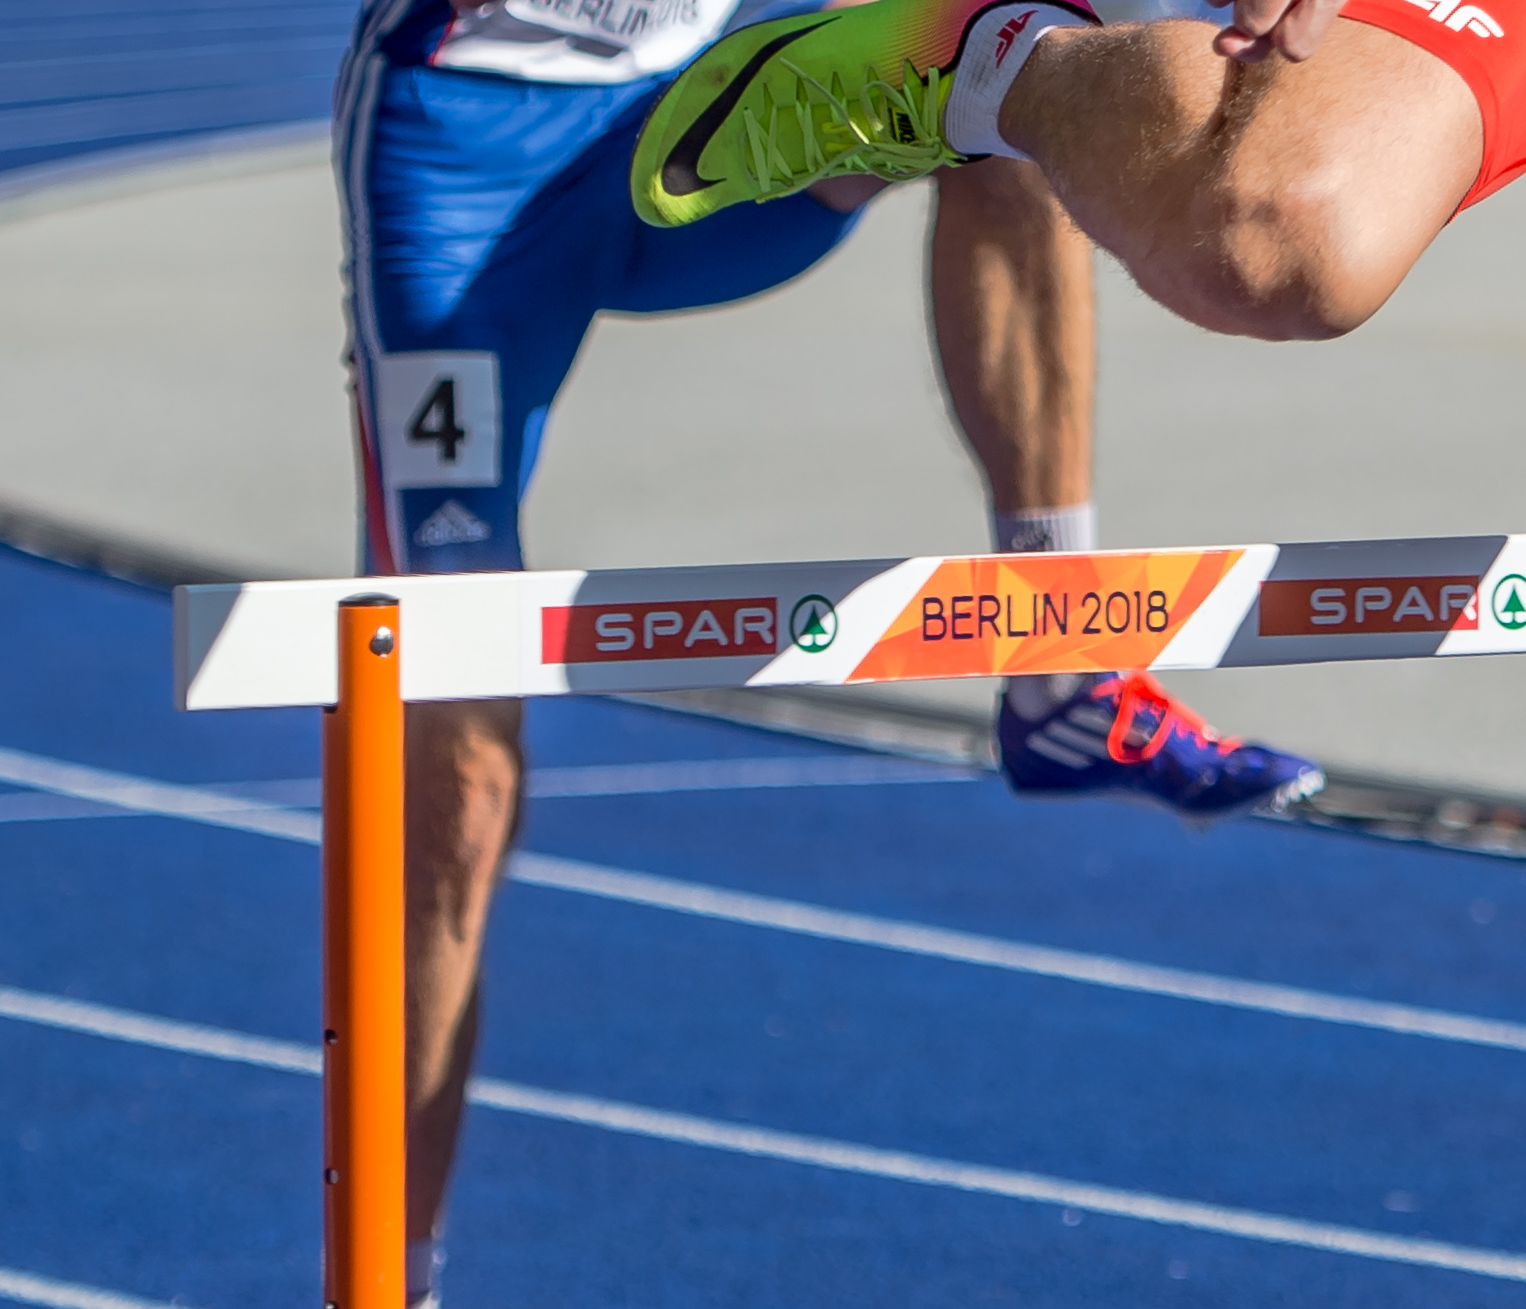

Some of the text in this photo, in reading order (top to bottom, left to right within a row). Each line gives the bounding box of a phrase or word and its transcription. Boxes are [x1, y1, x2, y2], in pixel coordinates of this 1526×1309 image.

[408, 376, 467, 464] 4
[594, 606, 775, 652] SPAR
[922, 589, 1169, 641] BERLIN 2018
[1309, 583, 1478, 626] SPAR
